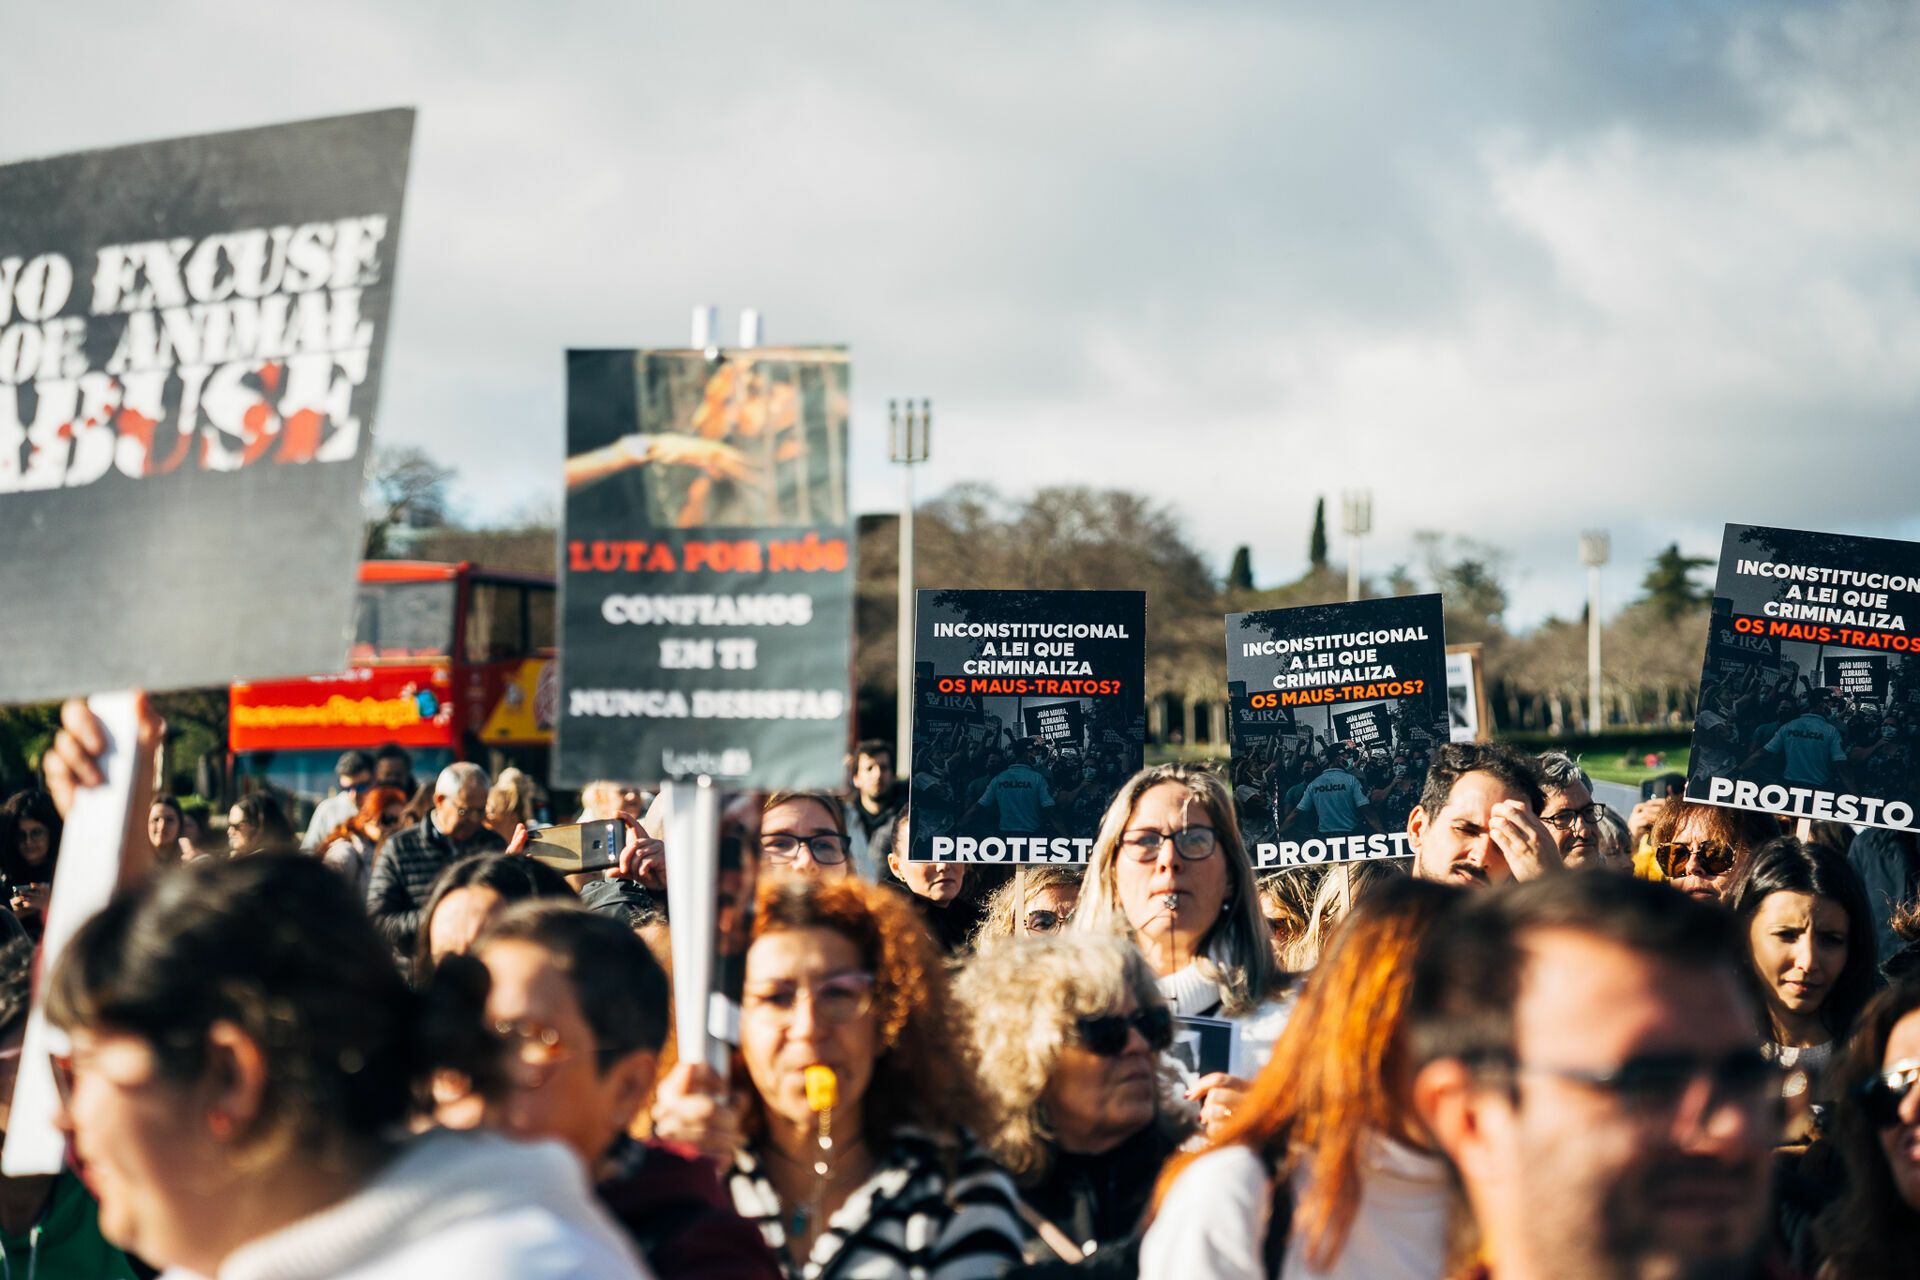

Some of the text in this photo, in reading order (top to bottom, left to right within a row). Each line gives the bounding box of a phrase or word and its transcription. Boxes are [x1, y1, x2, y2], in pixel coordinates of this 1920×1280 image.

[92, 214, 388, 316] EXCUSE
[0, 288, 375, 384] OR ANIMAL
[568, 533, 848, 573] LUTA POR NÓS
[1736, 559, 1920, 593] INCONSTITUCION
[601, 594, 813, 626] CONFIAMOS
[1785, 584, 1889, 609] A LEI QUE
[933, 623, 1129, 639] INCONSTITUCIONAL
[1763, 601, 1906, 631] CRIMINALIZA
[981, 642, 1075, 658] A LEI QUE
[1242, 626, 1429, 657] INCONSTITUCIONAL
[1734, 617, 1765, 634] OS
[1769, 621, 1920, 653] MAUS-TRATOS
[659, 638, 757, 669] EM TI
[963, 660, 1093, 675] CRIMINALIZA
[1290, 649, 1377, 670] A LEI QUE
[938, 678, 1121, 694] OS MAUS-TRATOS?
[1272, 665, 1396, 689] CRIMINALIZA
[569, 689, 843, 719] NUNCA DESISTAS
[1250, 680, 1425, 709] OS MAUS-TRATOS?
[1257, 709, 1288, 721] IRA
[1314, 783, 1346, 793] POLÍCIA
[1708, 777, 1914, 829] PROTESTO
[932, 836, 1095, 863] PROTEST
[1256, 832, 1416, 867] PROTEST
